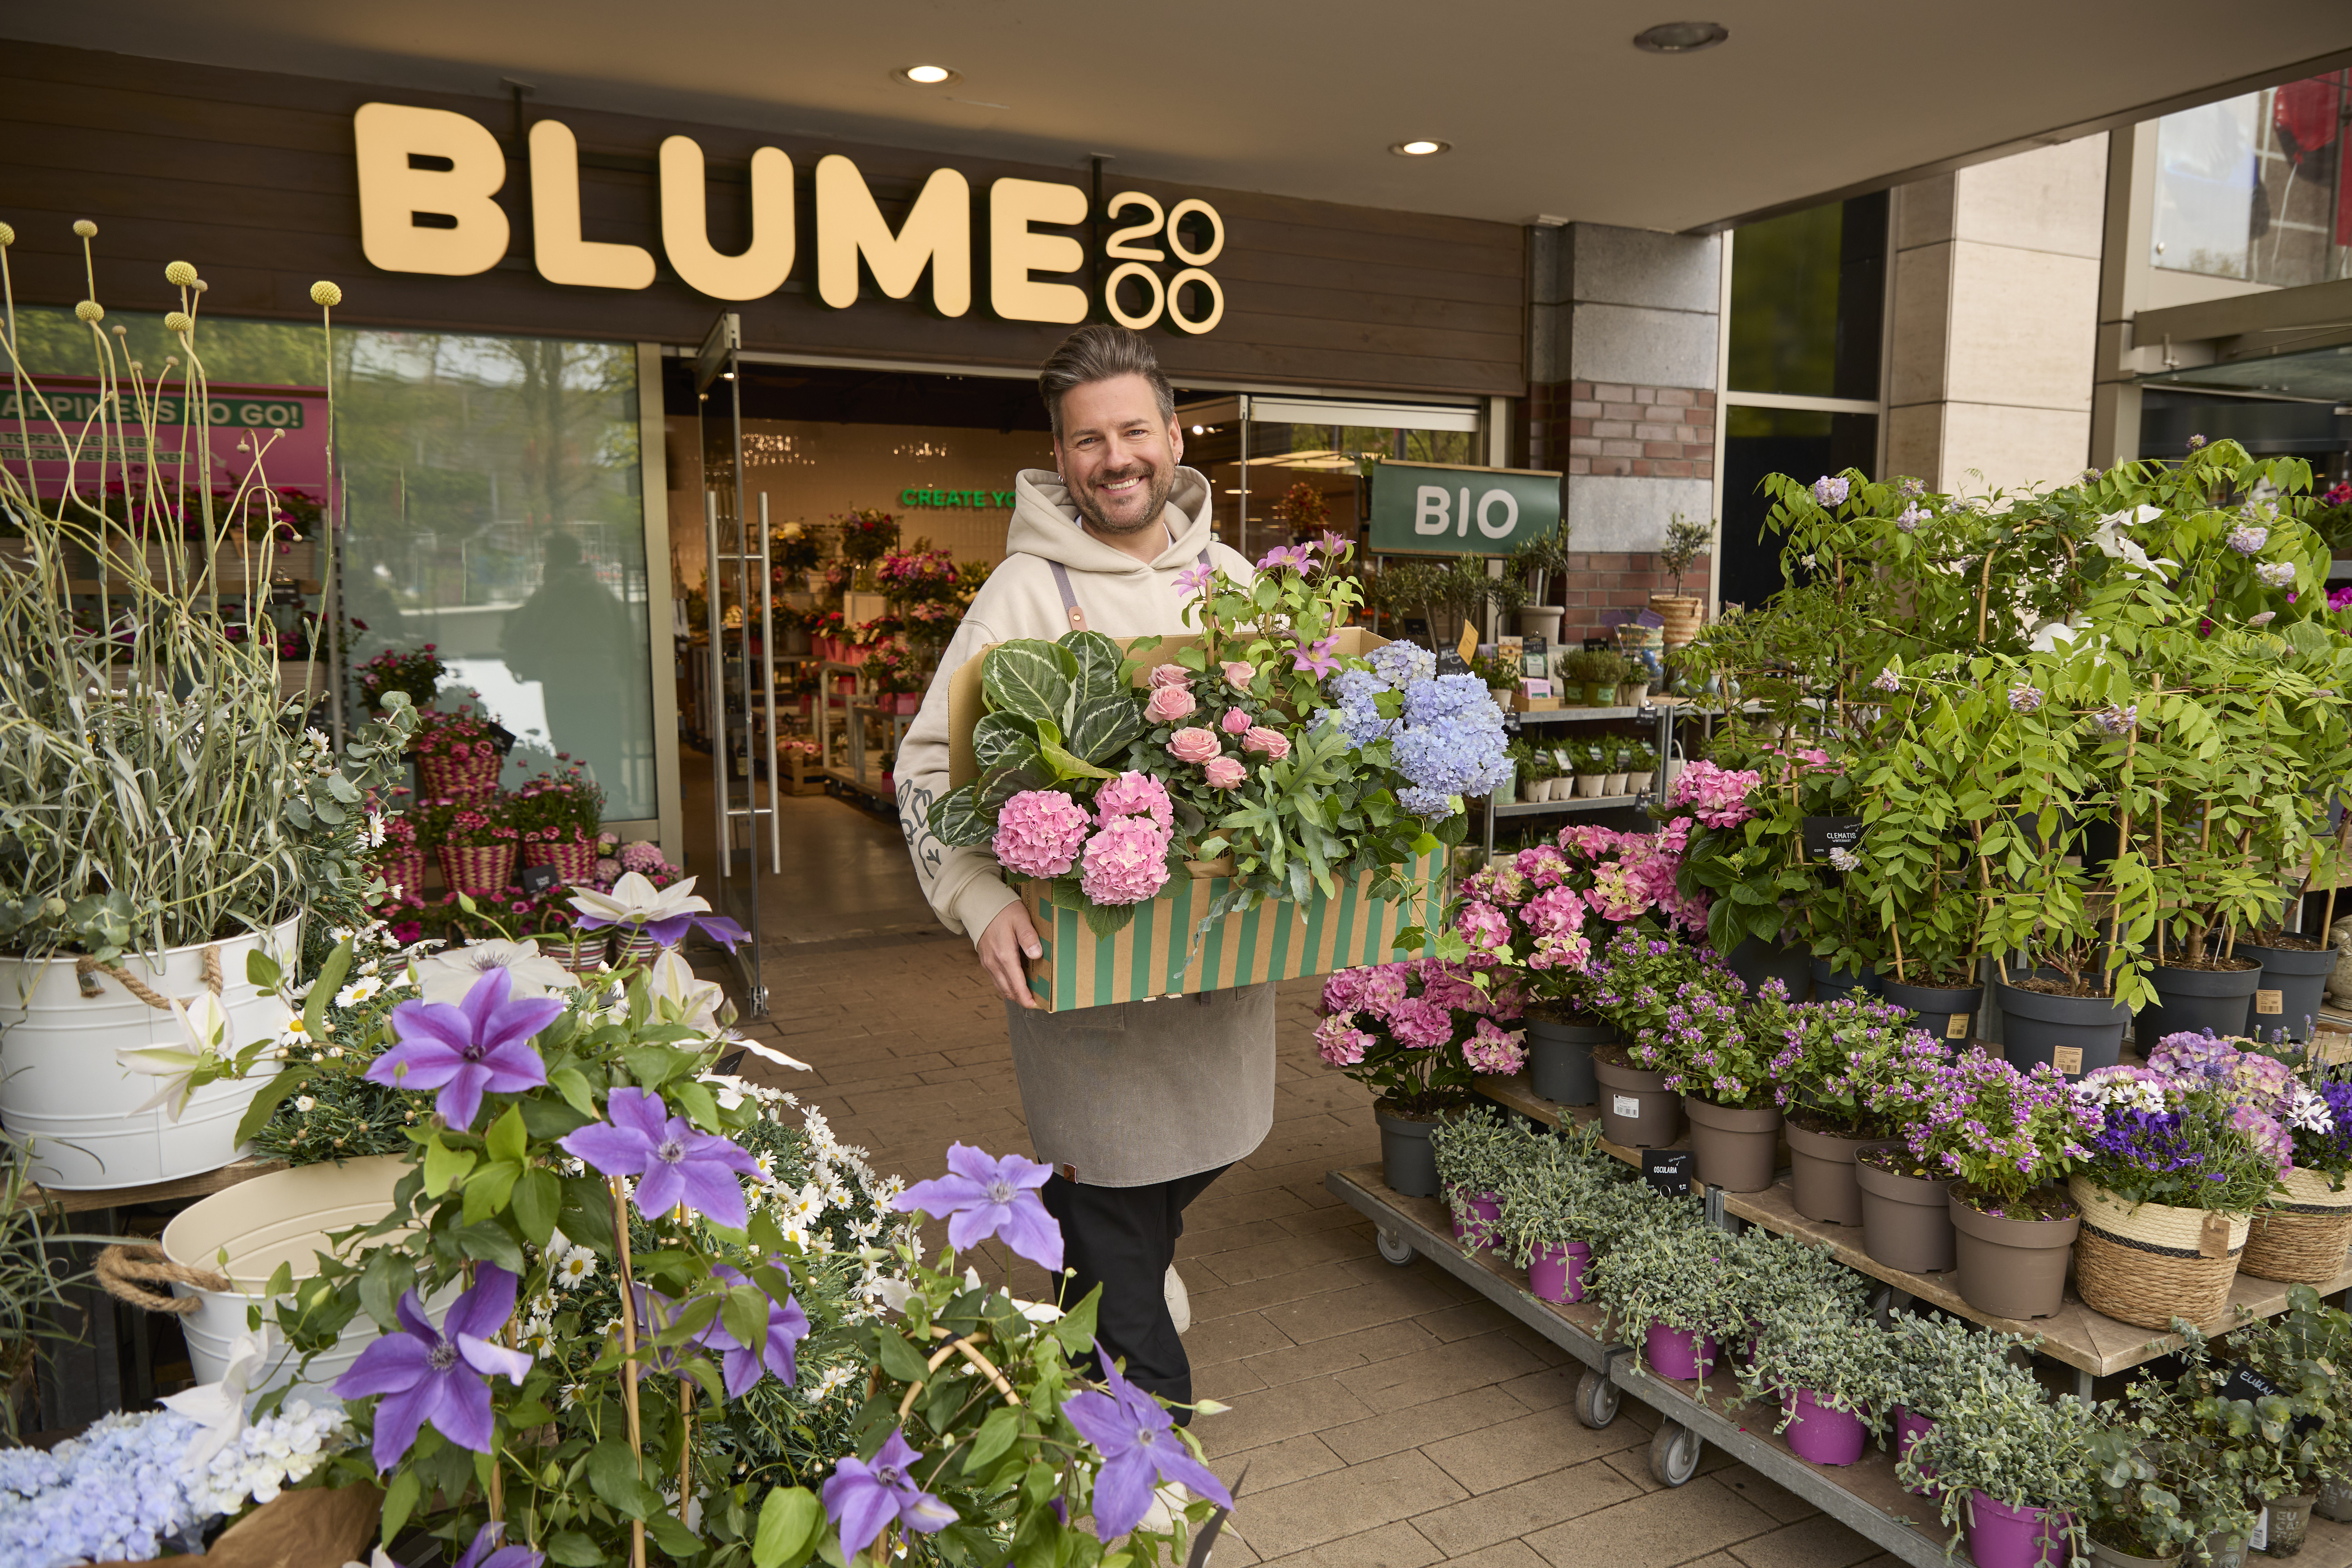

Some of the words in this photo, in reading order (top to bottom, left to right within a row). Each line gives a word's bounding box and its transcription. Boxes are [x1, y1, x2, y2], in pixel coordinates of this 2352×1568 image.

[354, 102, 1089, 324] BLUME
[1106, 191, 1225, 267] 20
[1105, 261, 1225, 334] 00
[184, 401, 232, 425] TO
[240, 403, 300, 427] GO!
[4, 433, 46, 444] TOPF
[113, 437, 160, 448] LIEB.
[902, 488, 985, 507] CREATE
[1414, 485, 1519, 539] BIO
[1183, 846, 1230, 862] BLME
